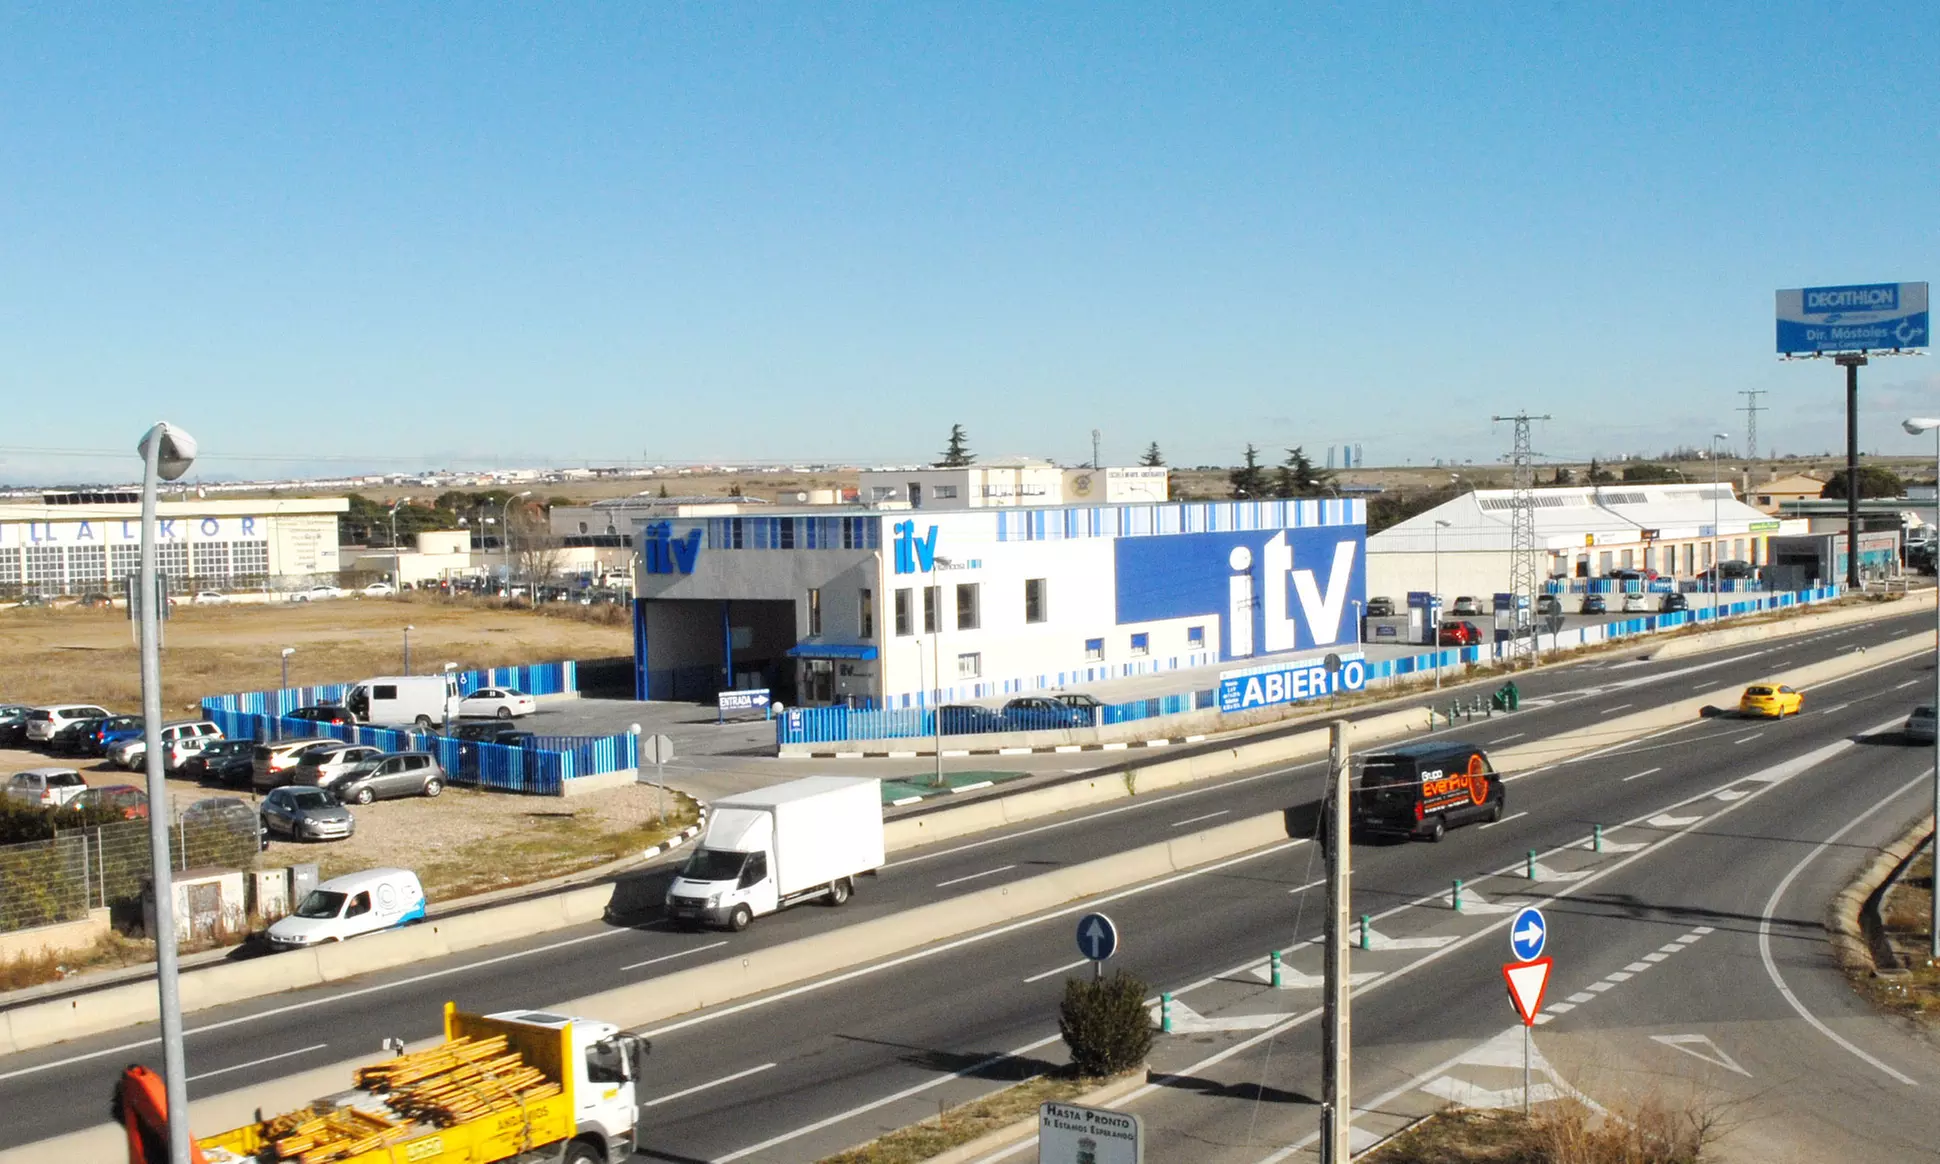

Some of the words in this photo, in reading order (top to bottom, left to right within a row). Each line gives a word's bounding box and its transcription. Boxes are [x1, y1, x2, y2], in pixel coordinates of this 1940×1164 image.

[1808, 288, 1893, 307] DECATHLON
[1807, 329, 1827, 340] Dir.
[0, 517, 255, 542] LLALKOR
[645, 519, 703, 574] itv
[894, 519, 938, 574] itv
[1229, 529, 1357, 657] itv
[1242, 662, 1365, 708] ABIERTO
[720, 696, 752, 707] ENTRADA
[1047, 1104, 1080, 1121] HASTA
[1086, 1112, 1130, 1128] PRONTO
[1054, 1119, 1088, 1133] ESTAMOS
[1090, 1125, 1135, 1141] ESPERANDO
